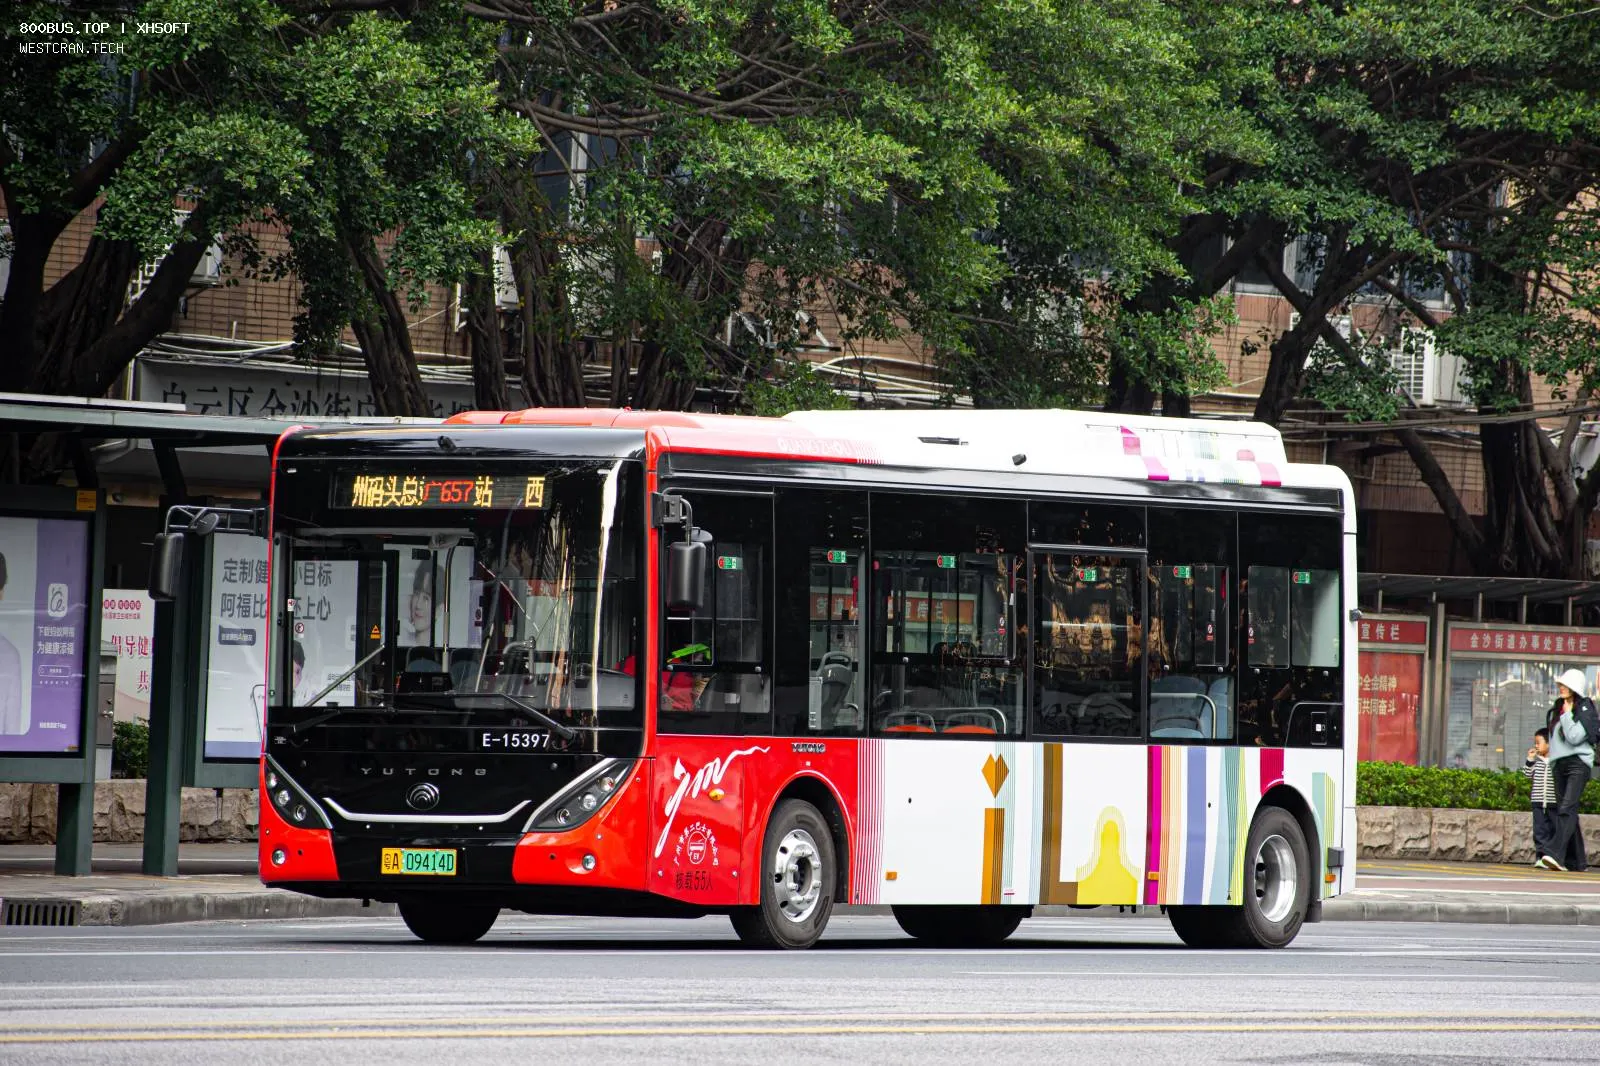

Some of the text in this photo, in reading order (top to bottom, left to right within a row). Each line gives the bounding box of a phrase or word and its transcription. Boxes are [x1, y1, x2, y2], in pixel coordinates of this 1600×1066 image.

[423, 480, 476, 503] 广657
[473, 475, 494, 508] 站
[524, 476, 546, 508] 西
[1360, 623, 1400, 641] 宣传栏
[1470, 631, 1589, 652] 金沙街道办事处宣传栏
[111, 634, 154, 656] 倡导健
[482, 733, 550, 748] E-15397
[361, 767, 487, 776] YUTONG
[406, 853, 454, 872] 09414D
